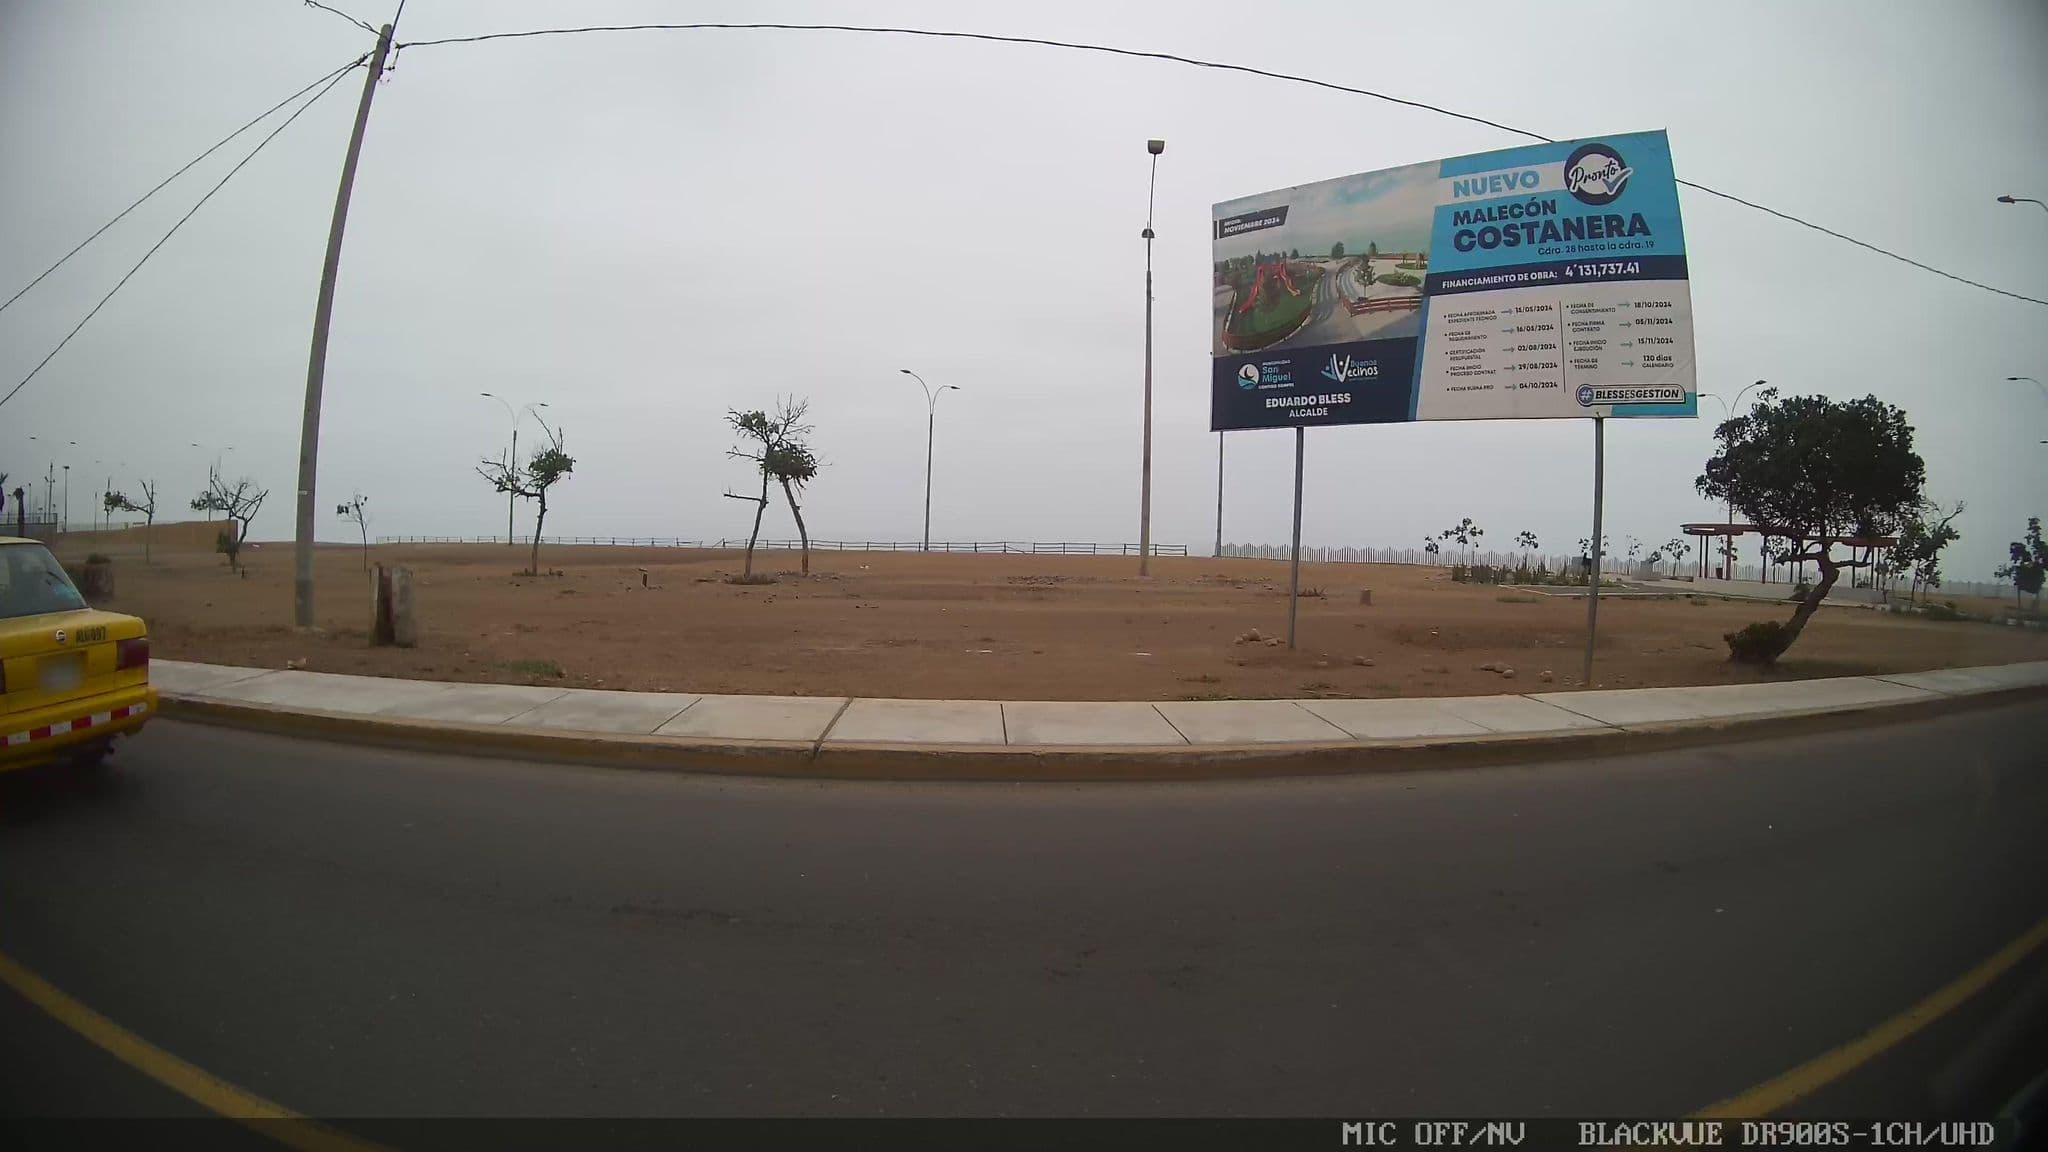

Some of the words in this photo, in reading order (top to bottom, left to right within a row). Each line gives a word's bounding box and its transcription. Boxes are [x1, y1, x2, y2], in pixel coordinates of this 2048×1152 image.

[1571, 160, 1618, 190] Pronto
[1453, 170, 1540, 198] NUEVO
[1453, 197, 1557, 227] MALECÓN
[1453, 213, 1652, 252] COSTANERA
[1538, 247, 1563, 256] Cdra.
[1565, 246, 1576, 254] 28
[1578, 243, 1606, 252] hasta
[1607, 242, 1617, 250] la
[1618, 240, 1643, 250] cdra.
[1645, 240, 1655, 249] 19
[1442, 276, 1516, 288] FINANCIAMIENTO
[1517, 273, 1529, 281] DE
[1530, 271, 1558, 280] OBRA:
[1634, 301, 1672, 309] 18/10/2024
[1635, 318, 1673, 326] 05/11/2024
[1638, 337, 1674, 345] 15/11/2024
[1518, 343, 1557, 352] 02/08/2024
[1262, 366, 1279, 374] San
[1262, 372, 1291, 383] Miguel
[1519, 382, 1558, 391] 04/10/2024
[1265, 395, 1317, 408] EDUARDO
[1318, 392, 1352, 405] BLESS
[1288, 407, 1329, 418] ALCALDE
